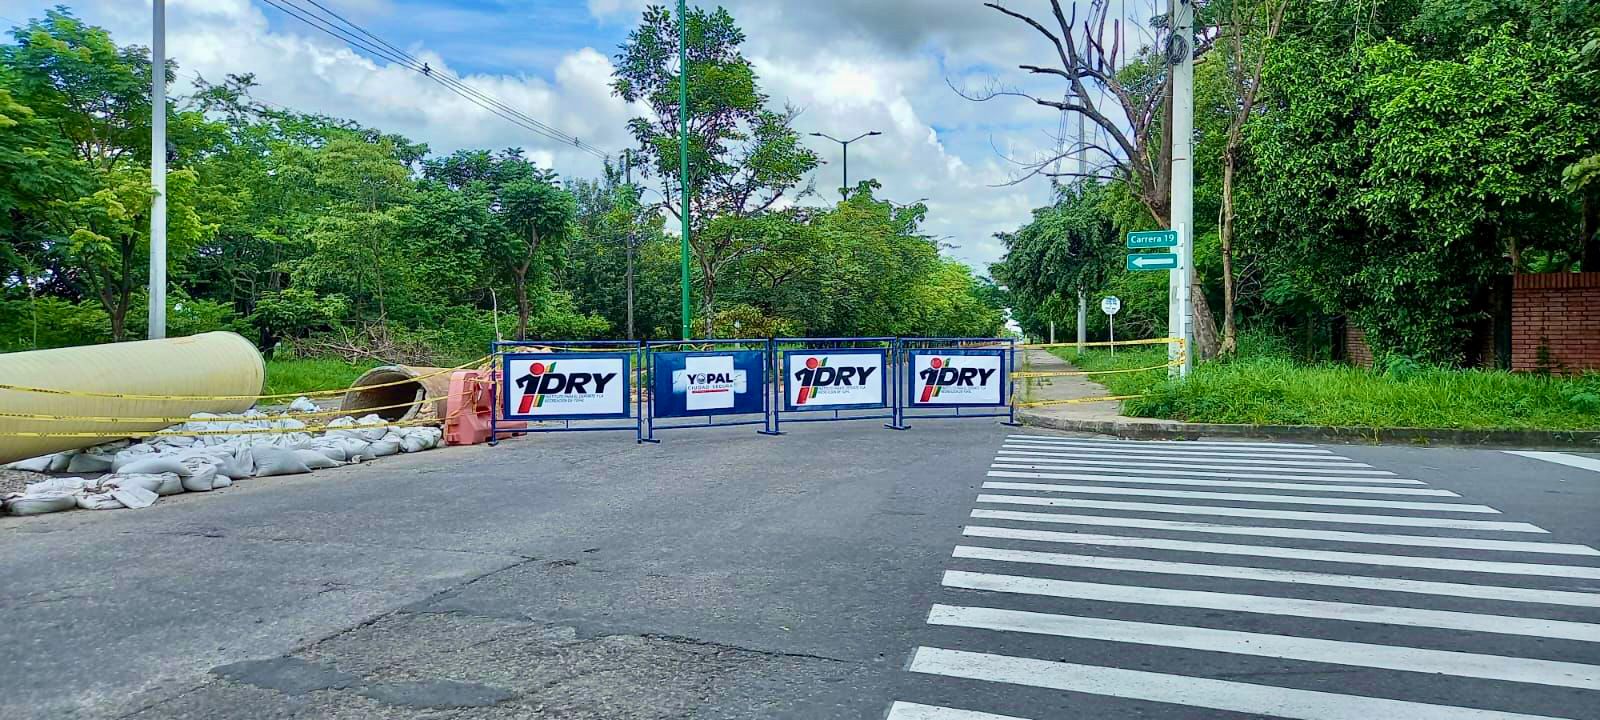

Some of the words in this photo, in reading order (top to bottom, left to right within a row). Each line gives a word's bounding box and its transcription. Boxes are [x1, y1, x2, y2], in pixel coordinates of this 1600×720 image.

[1131, 235, 1162, 244] Carrera
[1164, 234, 1174, 242] 19
[687, 372, 733, 385] YOPAL
